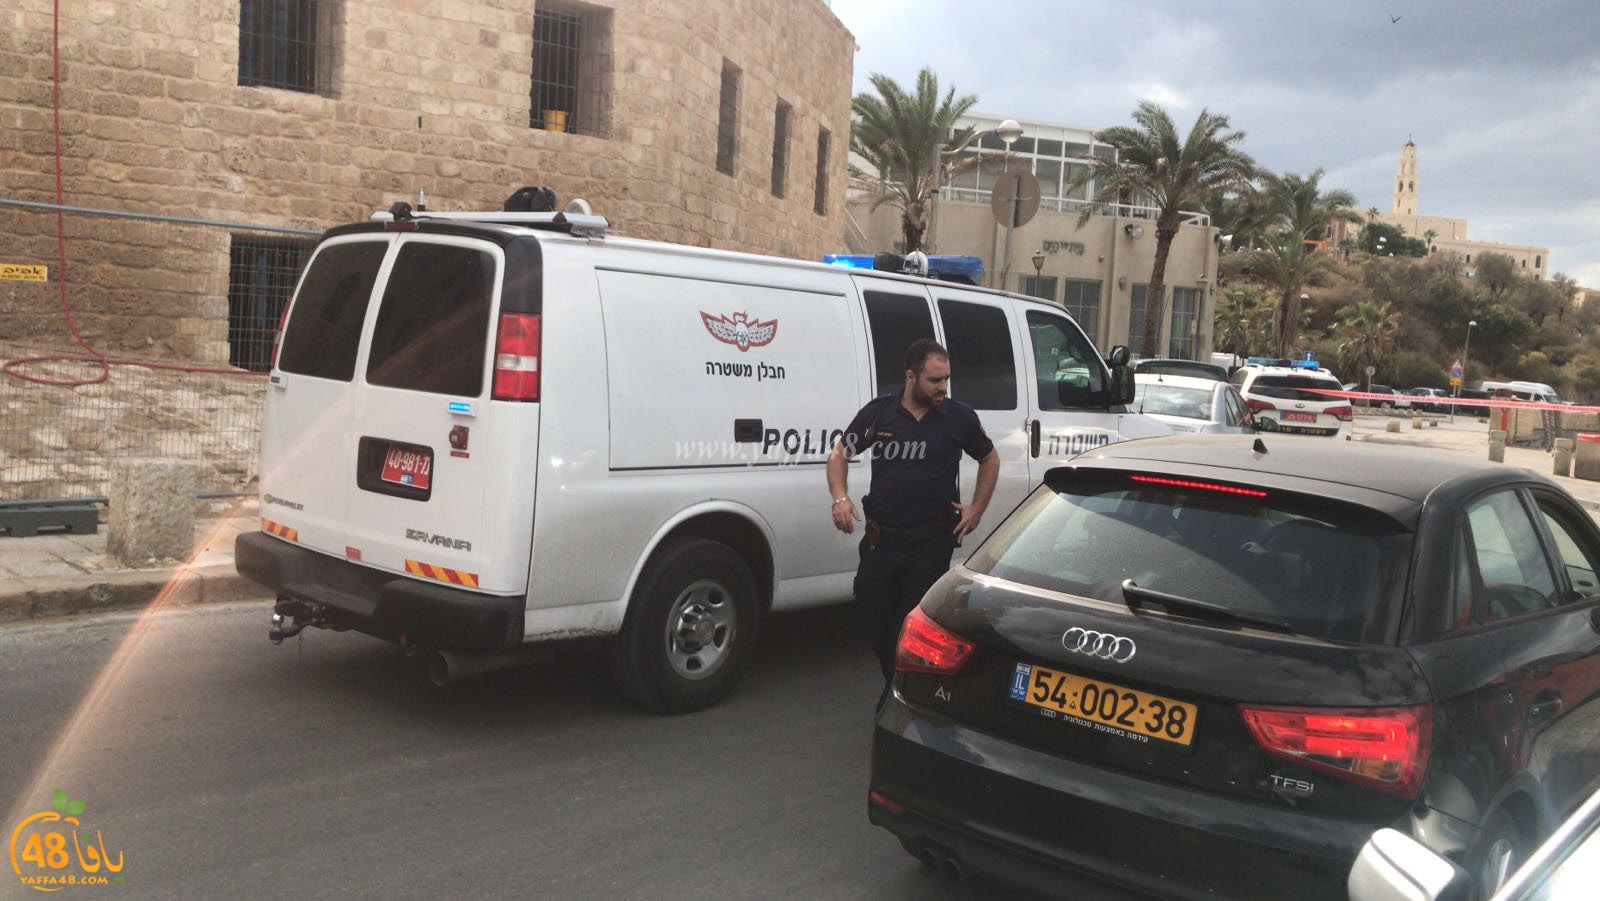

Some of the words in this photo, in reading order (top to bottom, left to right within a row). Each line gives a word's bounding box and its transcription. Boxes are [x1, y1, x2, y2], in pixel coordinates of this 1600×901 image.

[705, 361, 753, 378] משטרה
[757, 361, 786, 382] חבלן
[1014, 673, 1025, 690] IL
[934, 685, 952, 702] A1
[1270, 774, 1315, 792] TFSI
